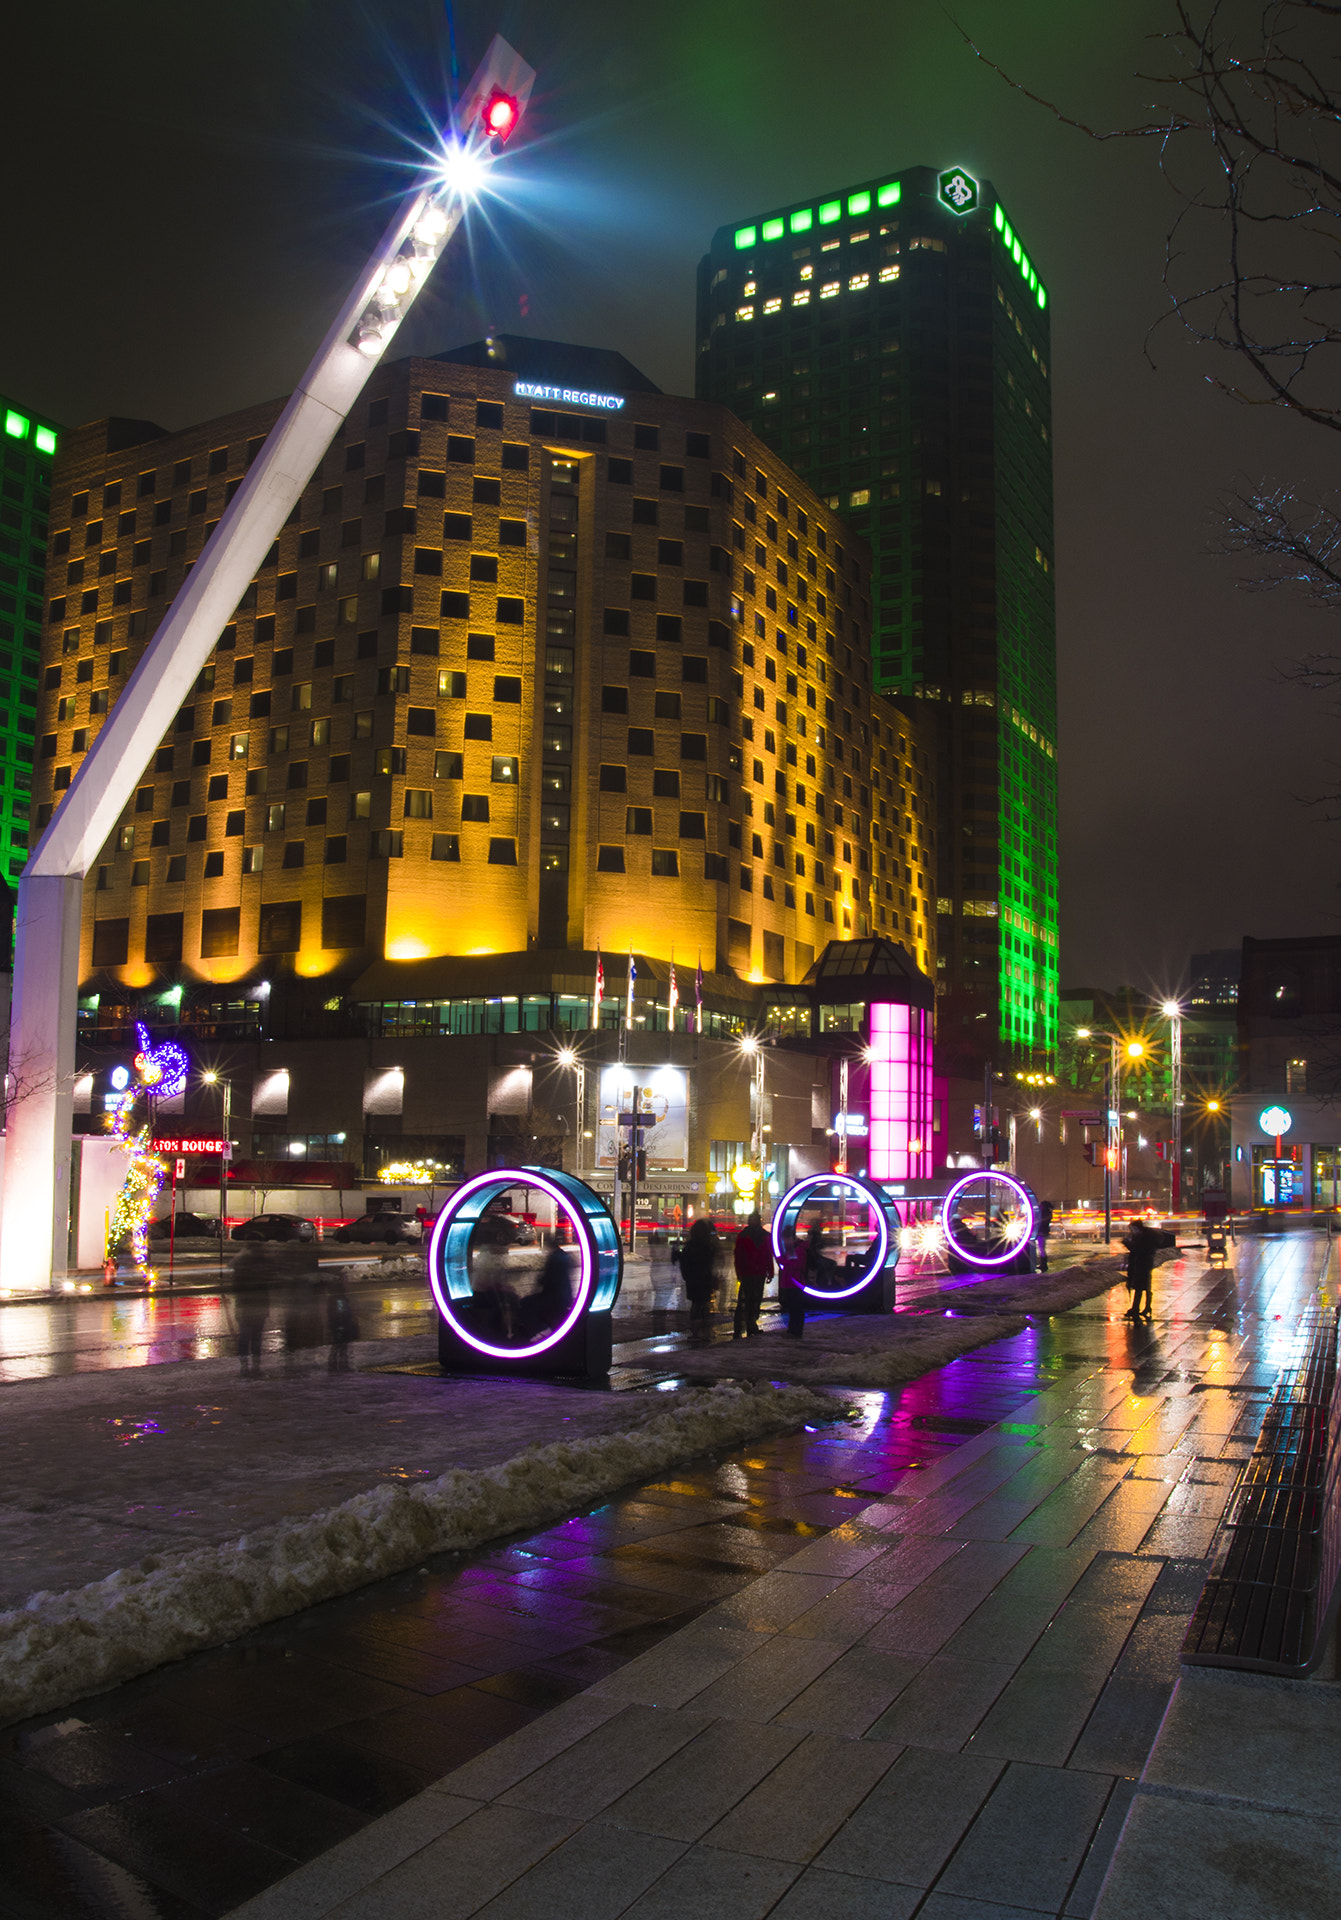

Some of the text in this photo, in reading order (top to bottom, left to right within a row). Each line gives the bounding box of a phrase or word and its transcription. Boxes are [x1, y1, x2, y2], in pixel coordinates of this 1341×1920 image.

[515, 382, 625, 409] HYATT REGENCY
[182, 1140, 223, 1152] ROUGE
[643, 1182, 690, 1191] DESJARDINS
